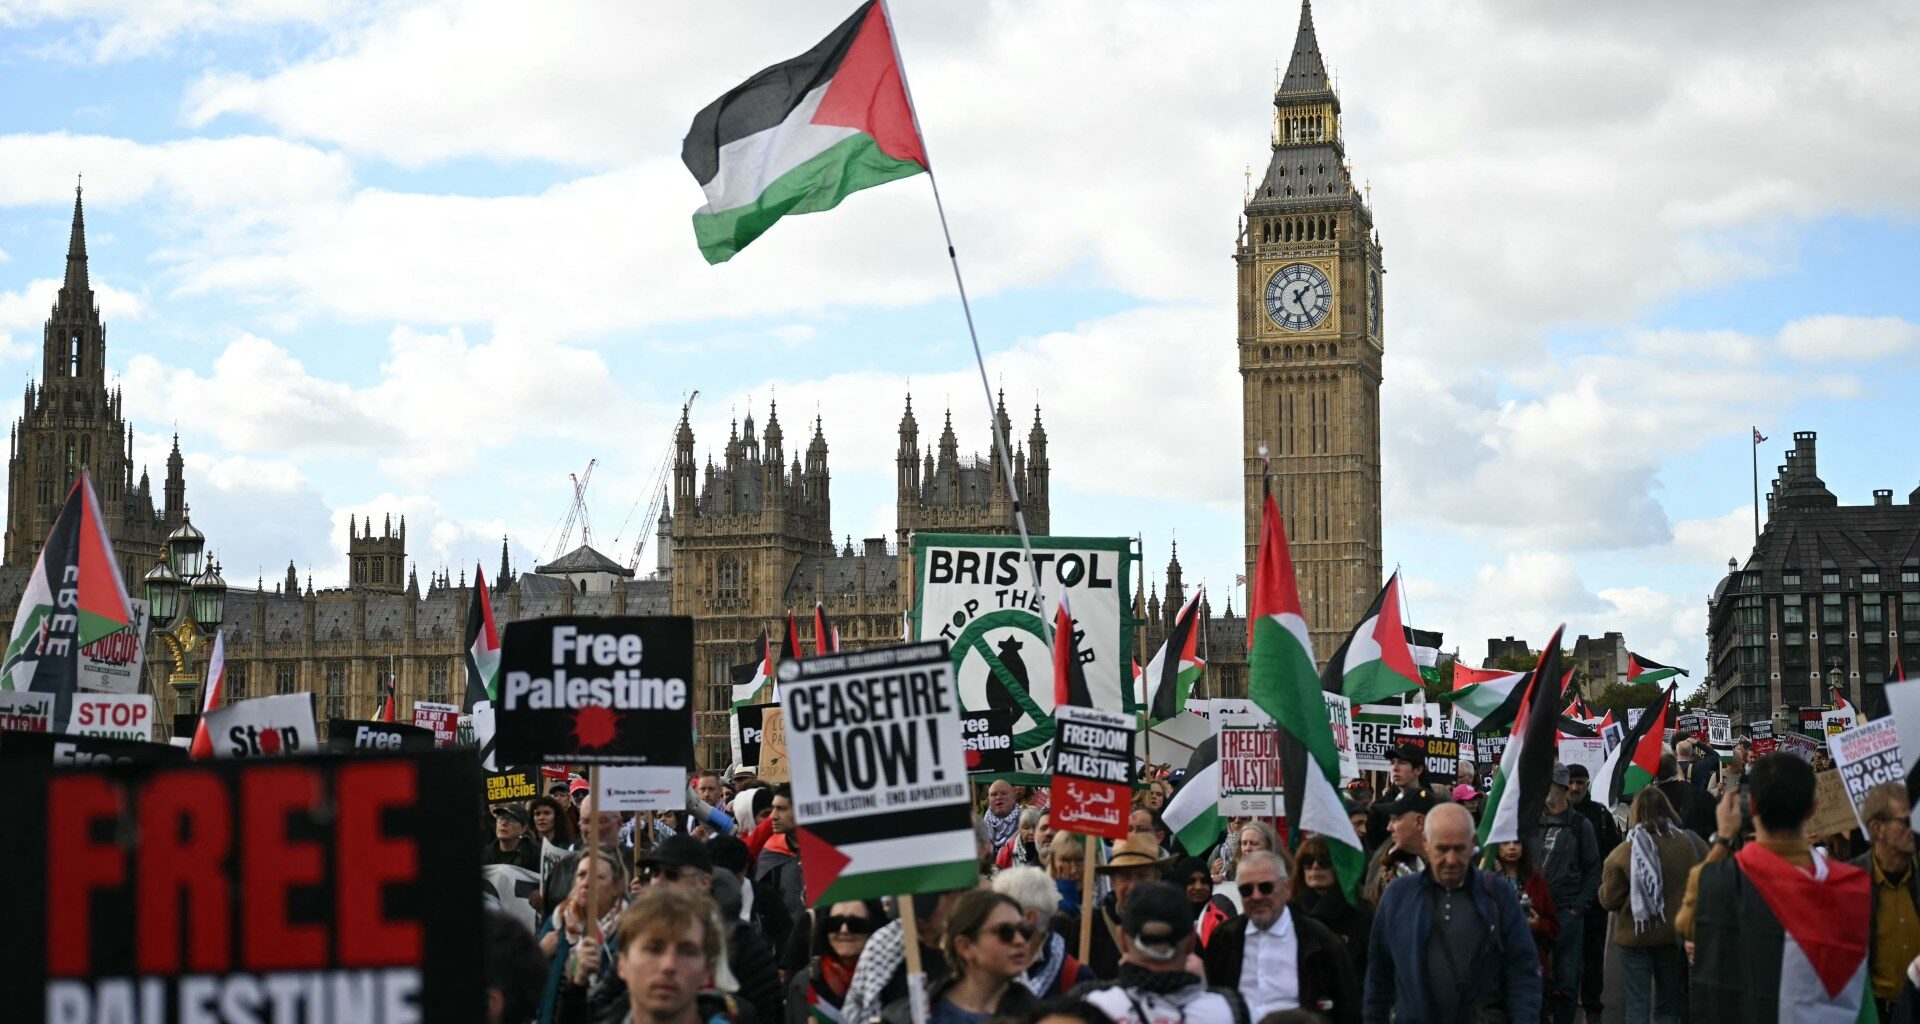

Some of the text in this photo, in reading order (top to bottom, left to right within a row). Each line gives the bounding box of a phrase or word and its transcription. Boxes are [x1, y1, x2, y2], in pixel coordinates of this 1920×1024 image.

[929, 550, 1112, 588] BRISTOL
[939, 599, 979, 641] TOP
[995, 589, 1045, 614] THE
[552, 625, 643, 667] Free
[505, 669, 687, 712] Palestine
[788, 668, 951, 733] CEASEFIRE
[78, 703, 147, 727] STOP
[960, 717, 989, 734] ree
[1804, 720, 1824, 730] ISRAE
[355, 725, 402, 750] Free
[434, 731, 454, 741] AINST
[960, 732, 1010, 751] estine
[1062, 723, 1128, 753] FREEDOM
[1453, 729, 1474, 744] PROT
[1841, 723, 1882, 743] NOVEMBER
[1841, 728, 1897, 753] INTERNATIONA
[1355, 742, 1395, 756] ALESTIN
[1428, 740, 1457, 757] GAZA
[1057, 752, 1131, 782] PALESTINE
[1221, 759, 1284, 787] PALESTIN
[1425, 757, 1457, 775] CIDE
[1843, 763, 1864, 779] NO
[1863, 755, 1881, 771] TO
[1848, 762, 1906, 794] RACIS
[487, 774, 526, 789] END THE
[487, 783, 536, 801] GENOCIDE
[799, 800, 824, 818] FREE
[46, 760, 424, 975] FREE
[44, 968, 424, 1024] PALESTINE
